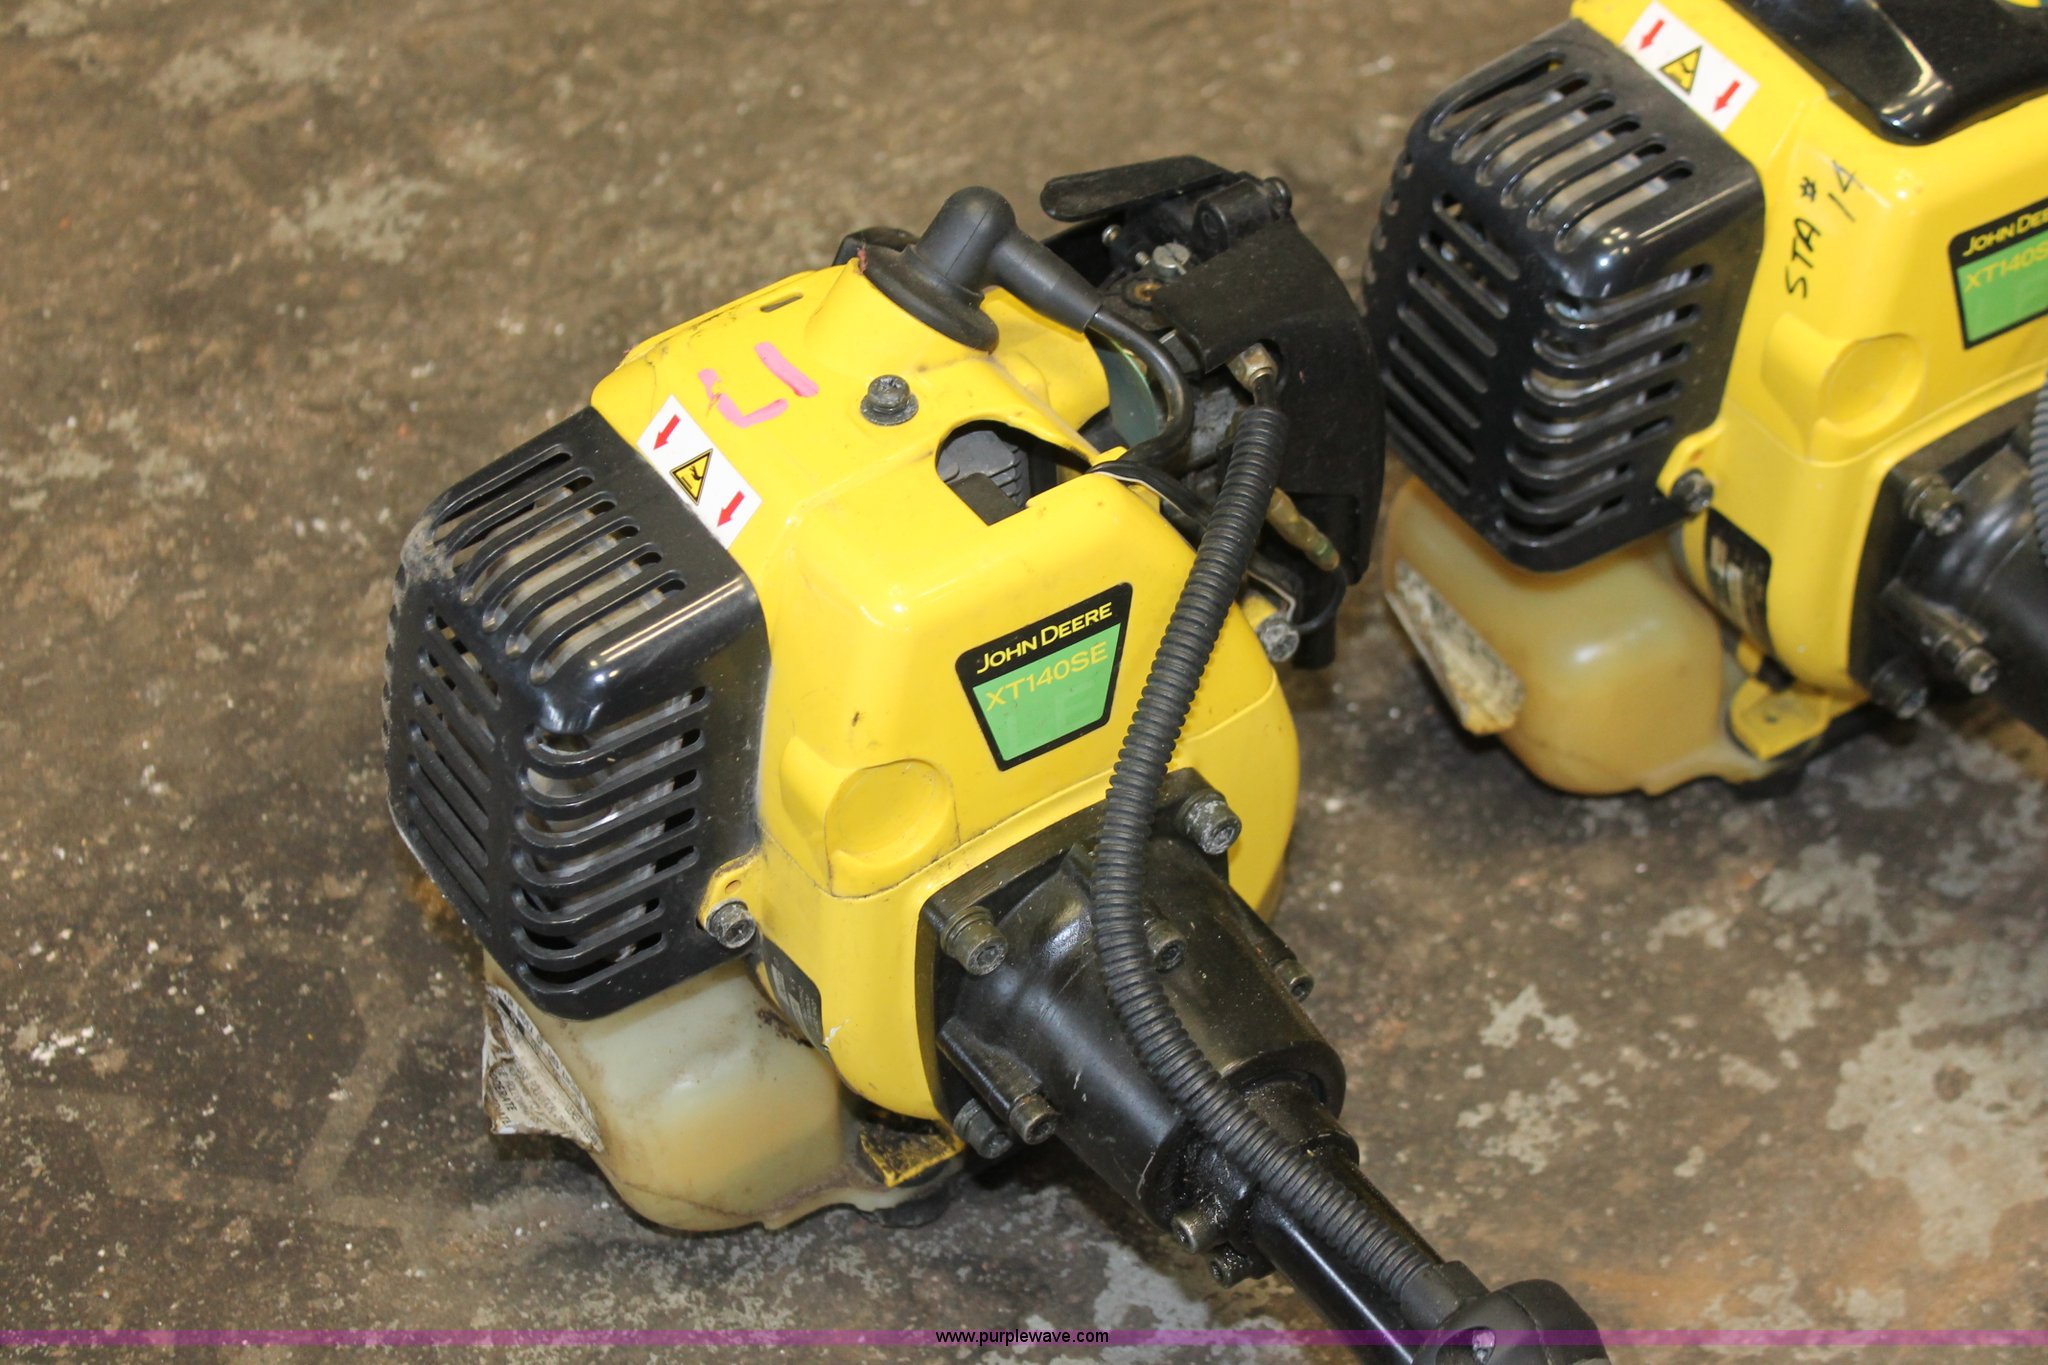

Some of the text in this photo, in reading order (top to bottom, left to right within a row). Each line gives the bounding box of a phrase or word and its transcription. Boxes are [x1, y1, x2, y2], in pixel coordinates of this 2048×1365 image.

[1785, 217, 1821, 298] STA
[1962, 222, 2016, 257] JOHN
[976, 601, 1113, 675] JOHN DEERE
[985, 640, 1109, 712] XT140SE
